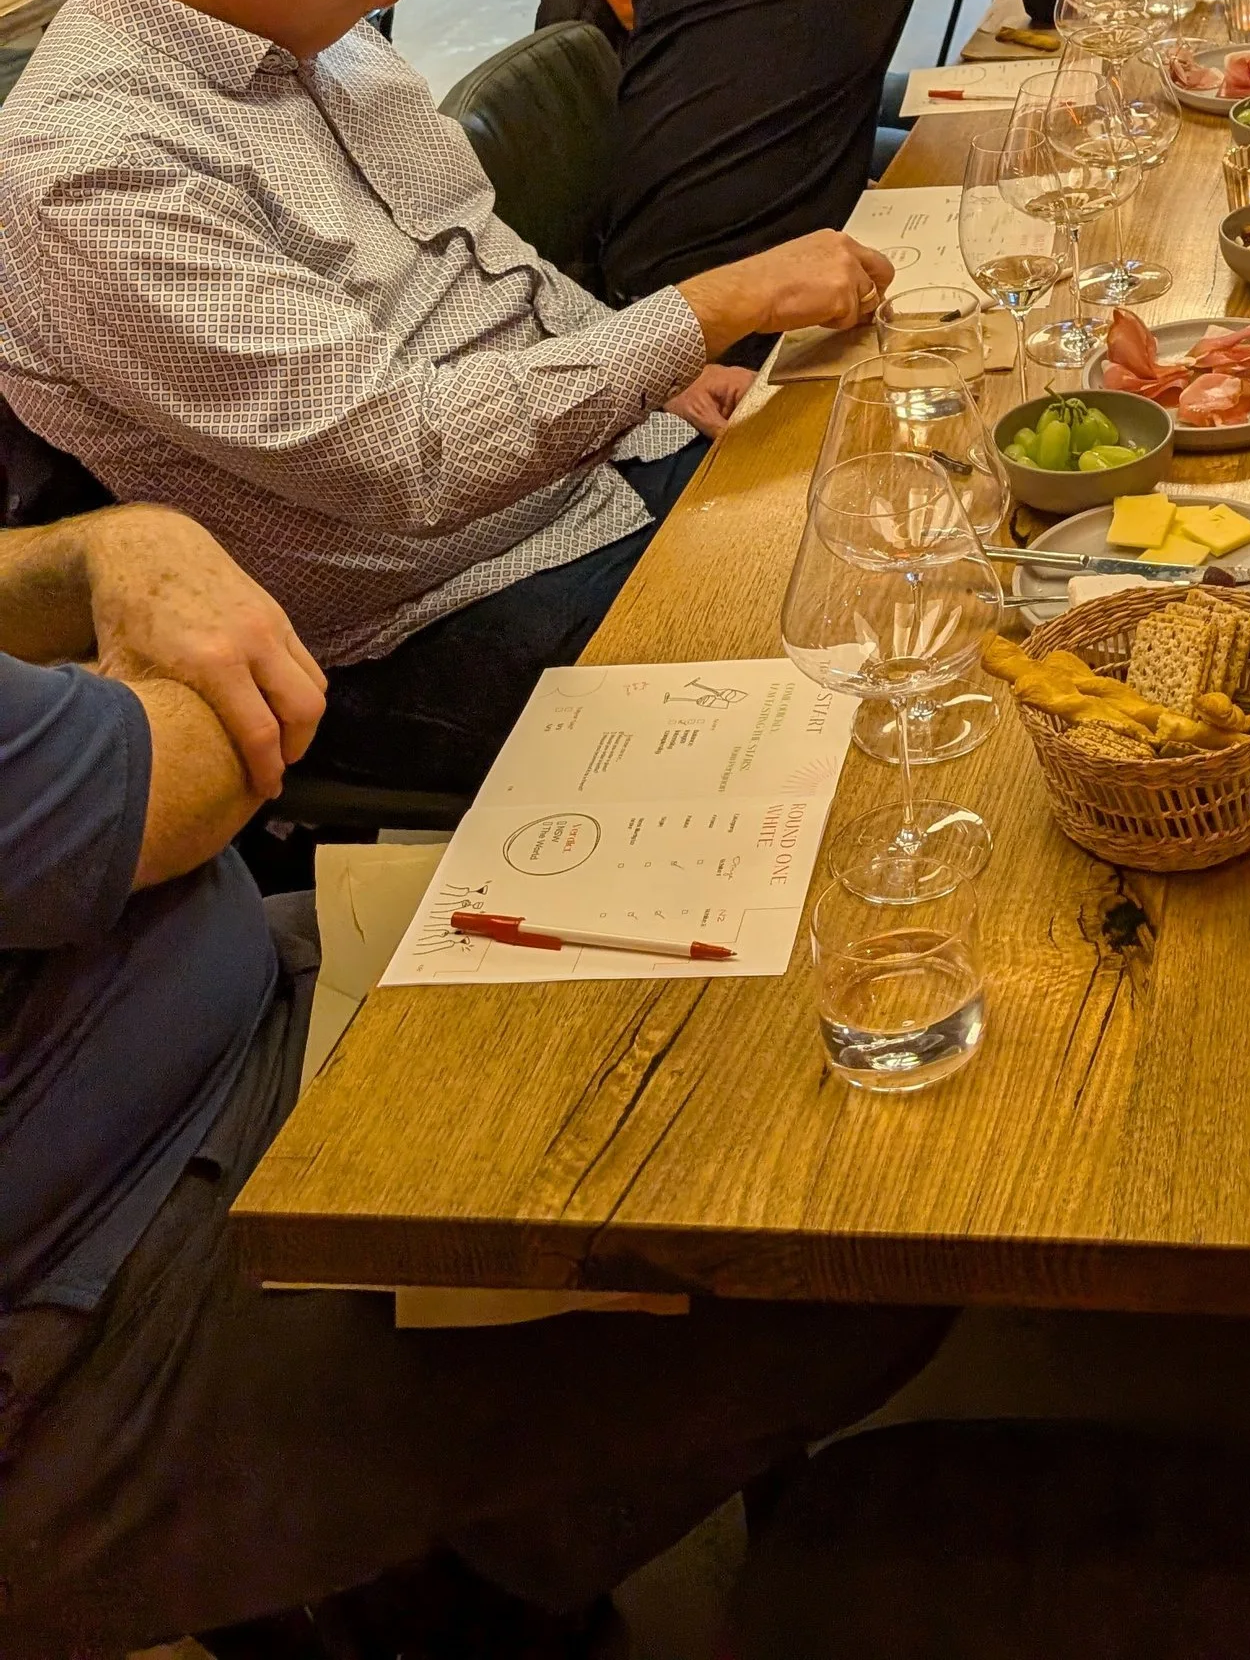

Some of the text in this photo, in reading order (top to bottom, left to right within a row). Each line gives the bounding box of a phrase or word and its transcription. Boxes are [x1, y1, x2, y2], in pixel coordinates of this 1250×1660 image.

[806, 692, 833, 734] START
[529, 826, 551, 860] The World
[551, 826, 565, 843] NSW
[757, 804, 784, 848] WHITE
[770, 803, 807, 885] ROUND ONE
